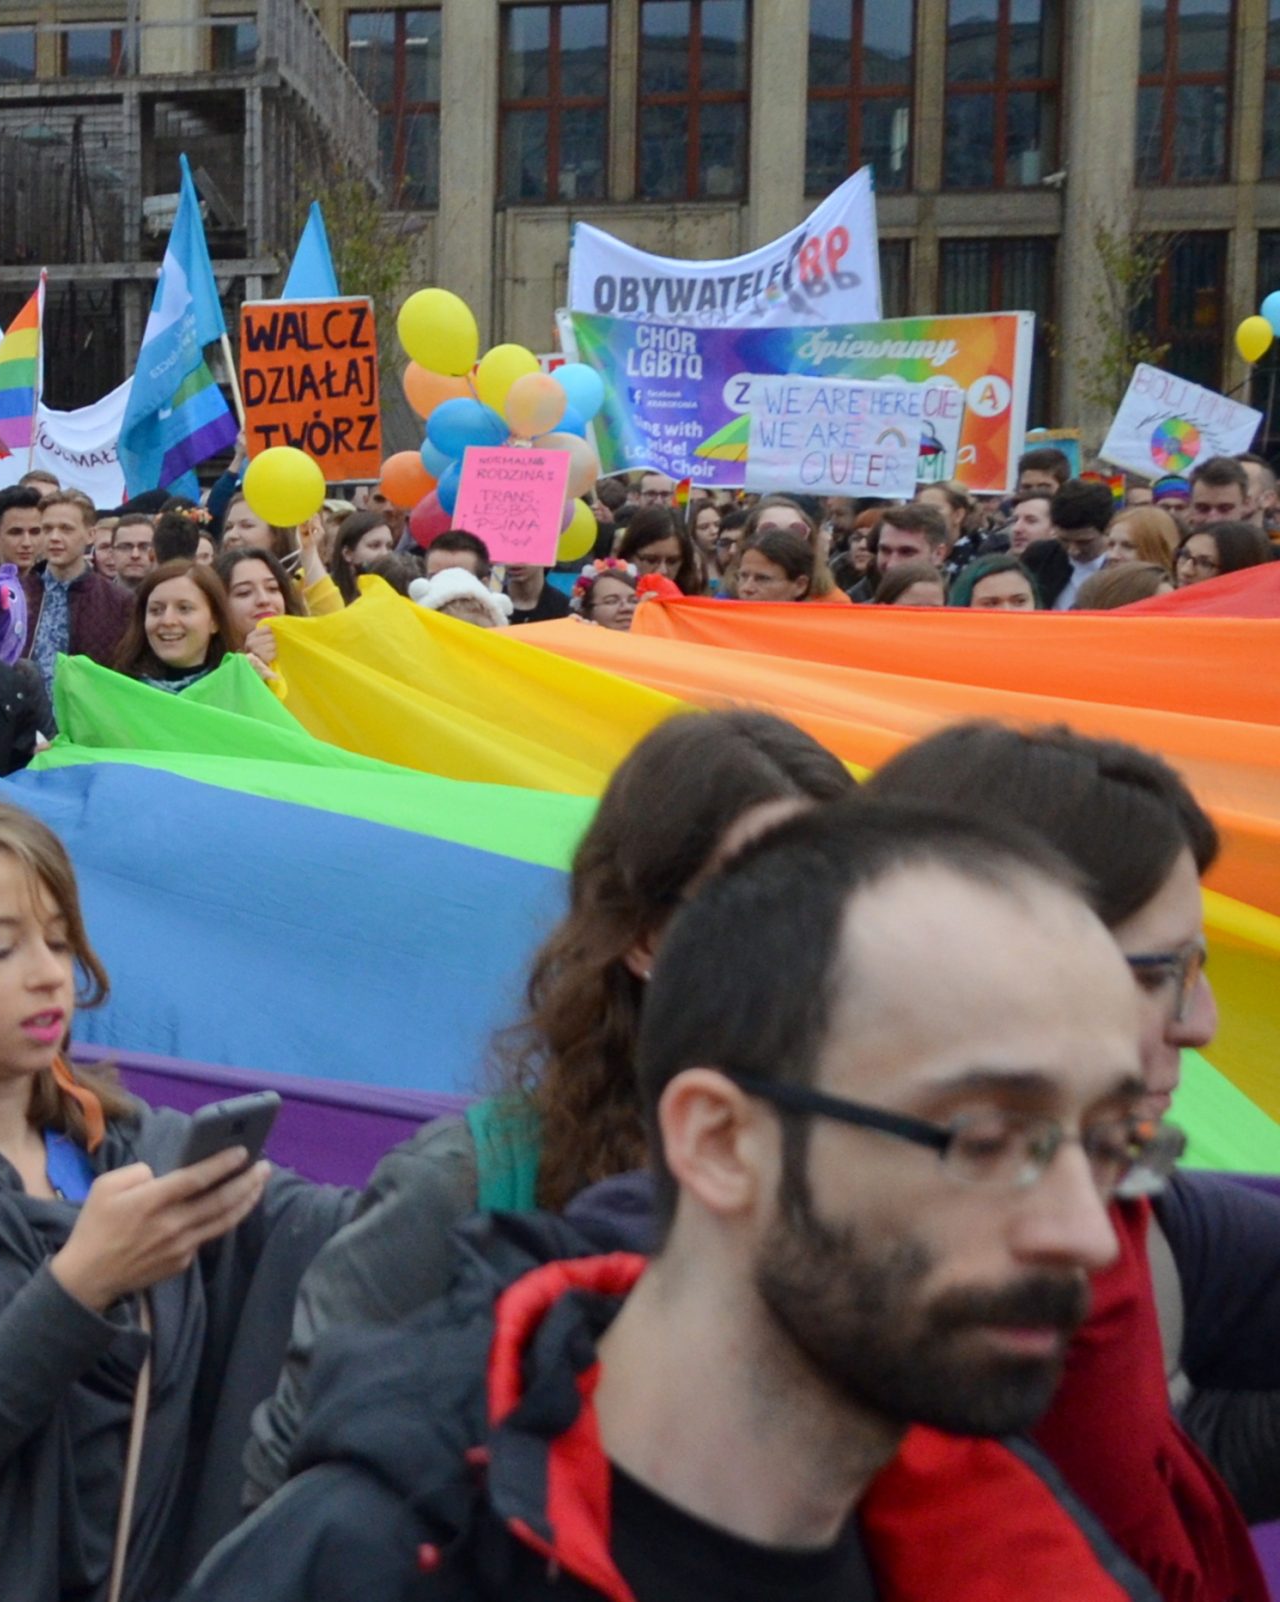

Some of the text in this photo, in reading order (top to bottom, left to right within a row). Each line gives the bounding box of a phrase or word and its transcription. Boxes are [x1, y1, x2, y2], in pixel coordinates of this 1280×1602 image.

[244, 307, 370, 353] WALCZ
[635, 325, 697, 354] CHÓR
[626, 348, 703, 380] LGBTQ
[243, 355, 376, 407] DZIAŁAJ
[764, 387, 920, 417] WE ARE HERE
[254, 410, 378, 456] TWÓRZ
[665, 421, 704, 438] with
[760, 422, 863, 449] WE ARE
[671, 459, 716, 478] Choir
[800, 451, 901, 486] QUEER
